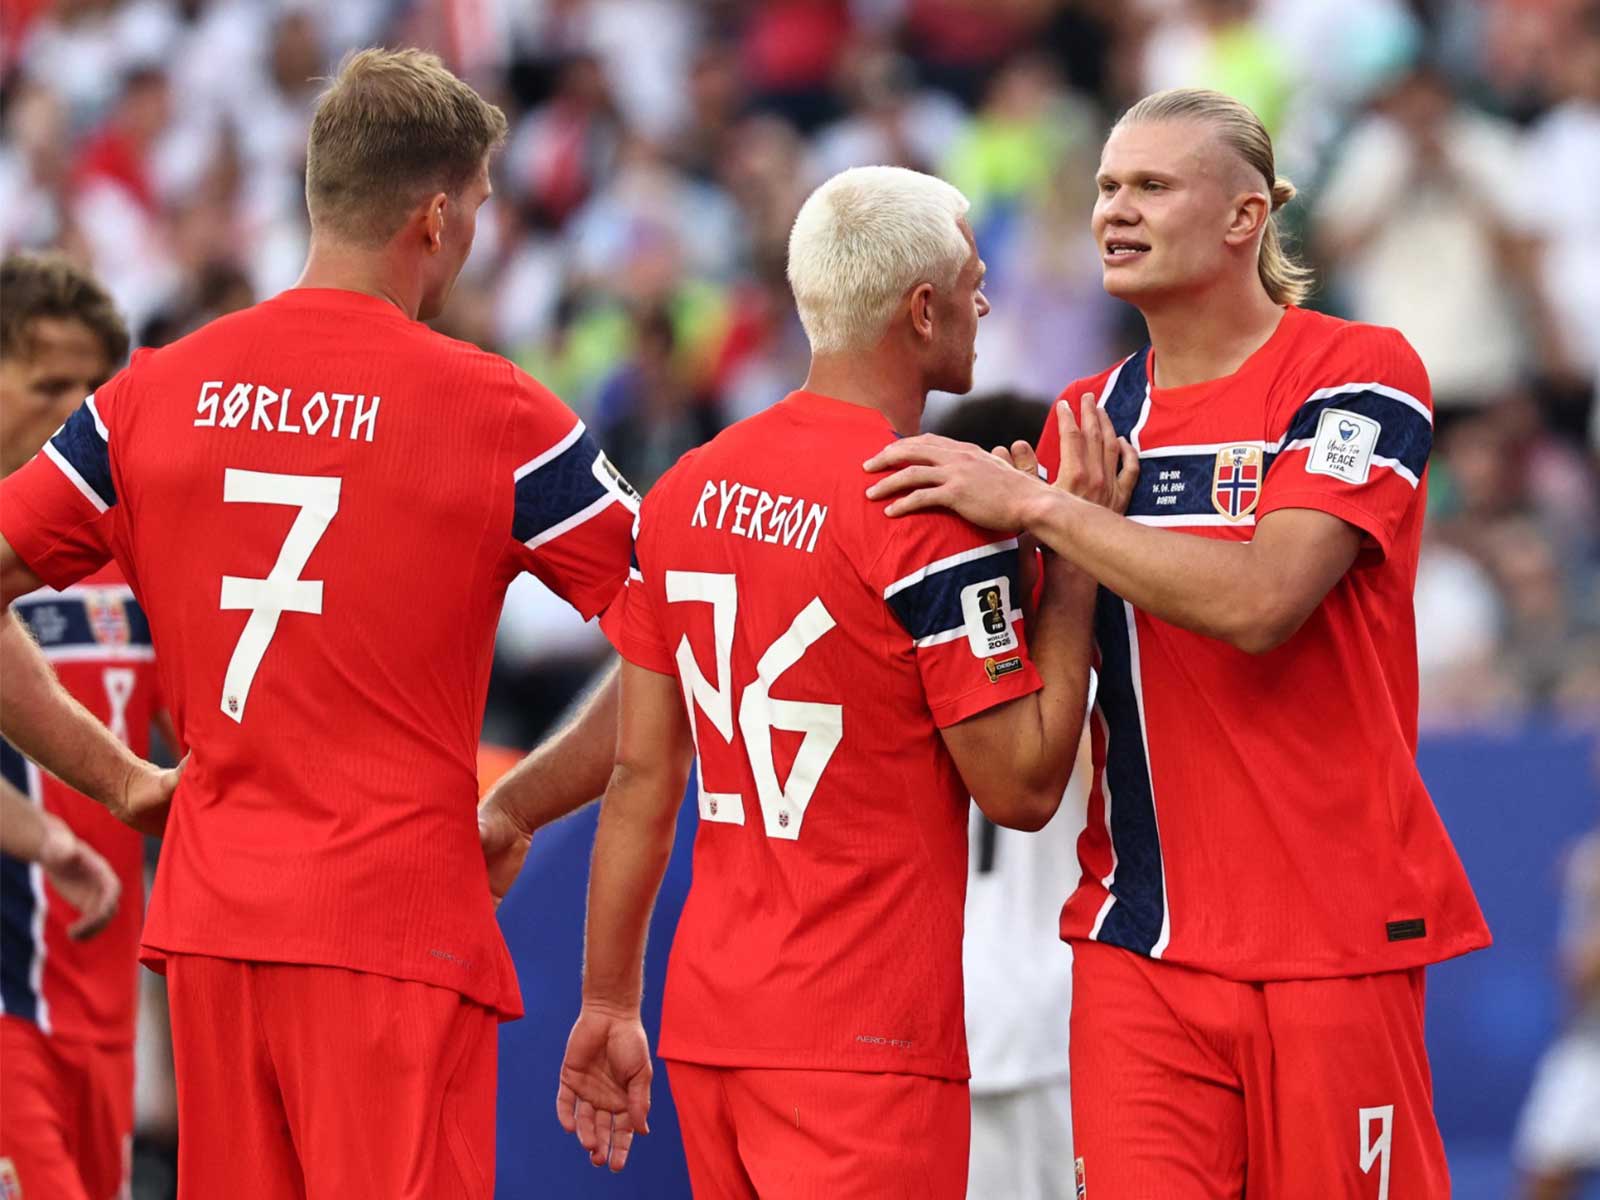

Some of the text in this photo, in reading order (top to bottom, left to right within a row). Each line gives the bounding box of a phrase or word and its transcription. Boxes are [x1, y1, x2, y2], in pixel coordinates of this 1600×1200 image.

[193, 381, 381, 442] SØRLOTH
[1326, 452, 1356, 468] PEACE
[1329, 463, 1345, 472] FIFA
[691, 479, 828, 553] RYERSON
[219, 467, 342, 724] 7
[996, 659, 1019, 670] DEBUT
[665, 569, 844, 841] 26
[856, 1035, 912, 1049] AERO-FIT
[1359, 1104, 1394, 1200] 9
